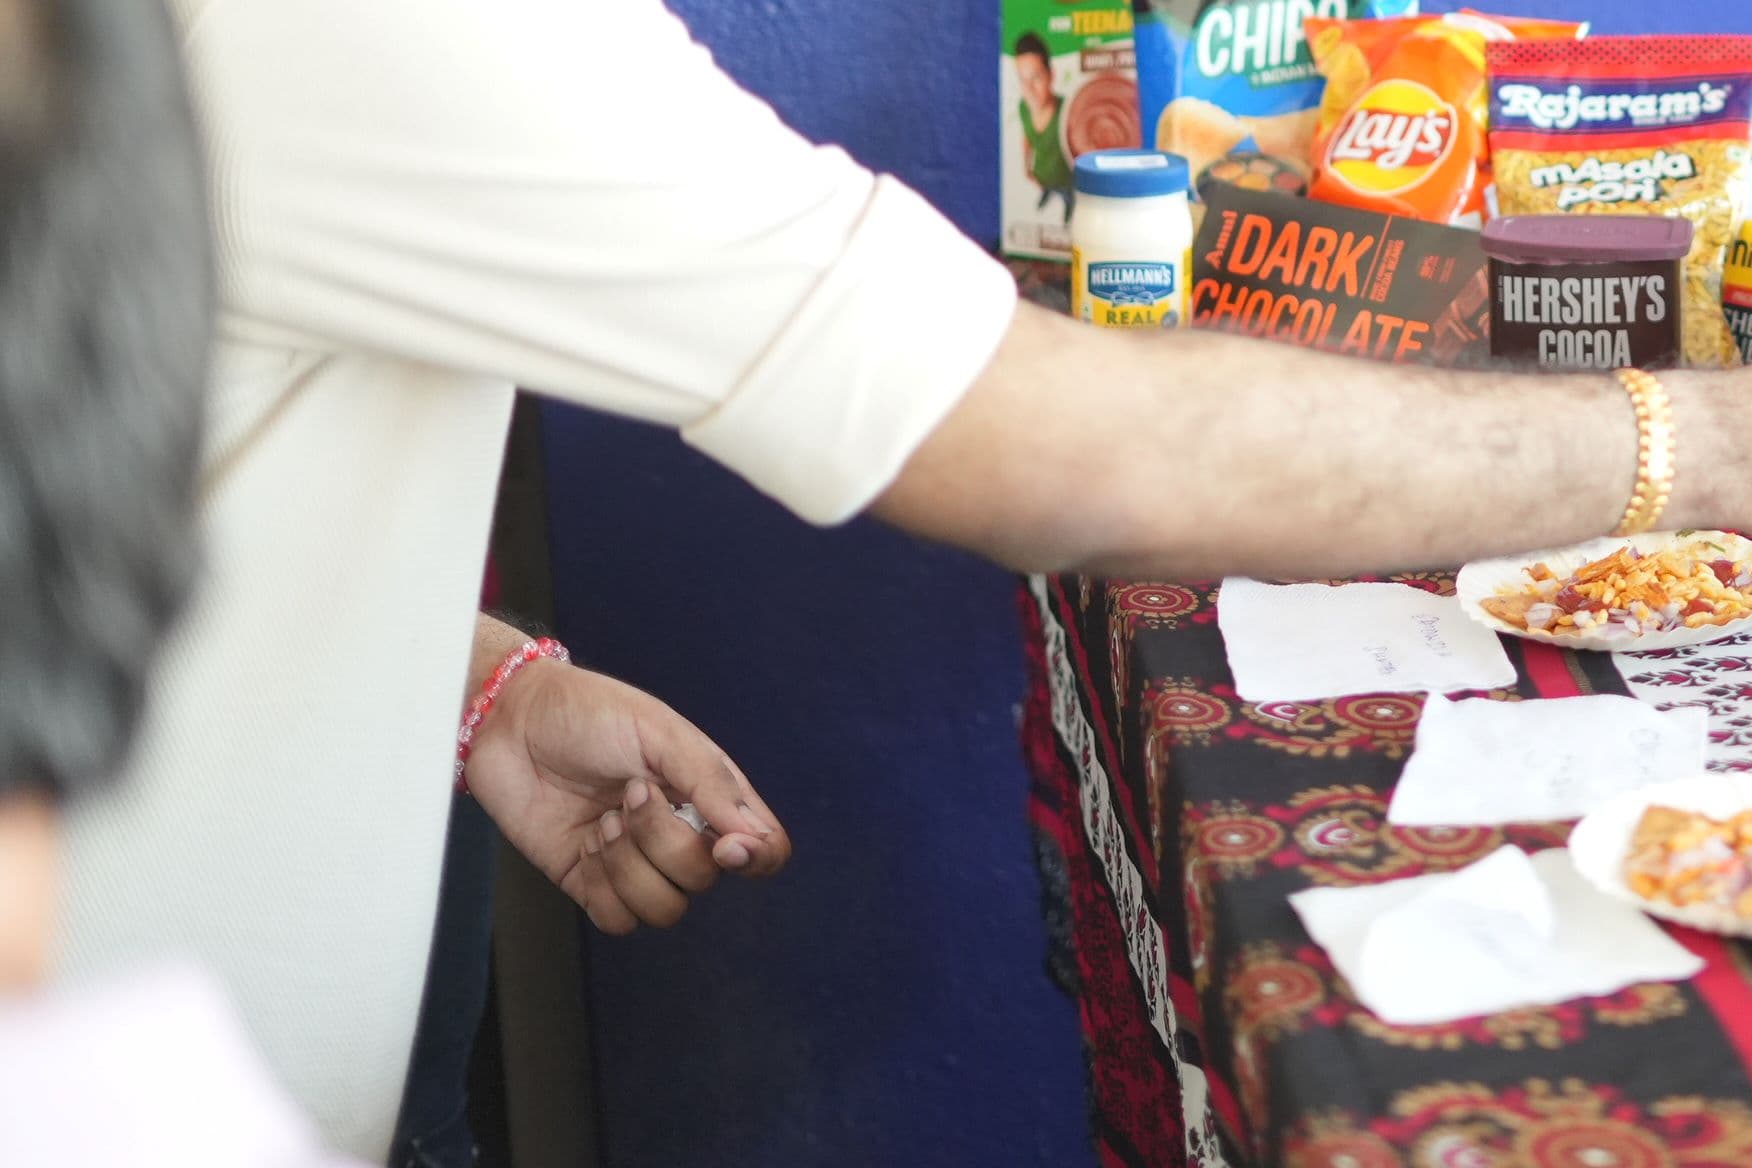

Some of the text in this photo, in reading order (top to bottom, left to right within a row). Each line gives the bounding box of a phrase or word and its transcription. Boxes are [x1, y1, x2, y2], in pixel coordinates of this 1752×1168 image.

[1072, 9, 1134, 36] TEENA
[1498, 82, 1727, 129] Rajaram's
[1331, 109, 1450, 171] Lay's
[1227, 214, 1374, 297] DARK
[1106, 309, 1156, 325] REAL
[1502, 275, 1666, 323] HERSHEY'S
[1538, 329, 1632, 369] COCOA
